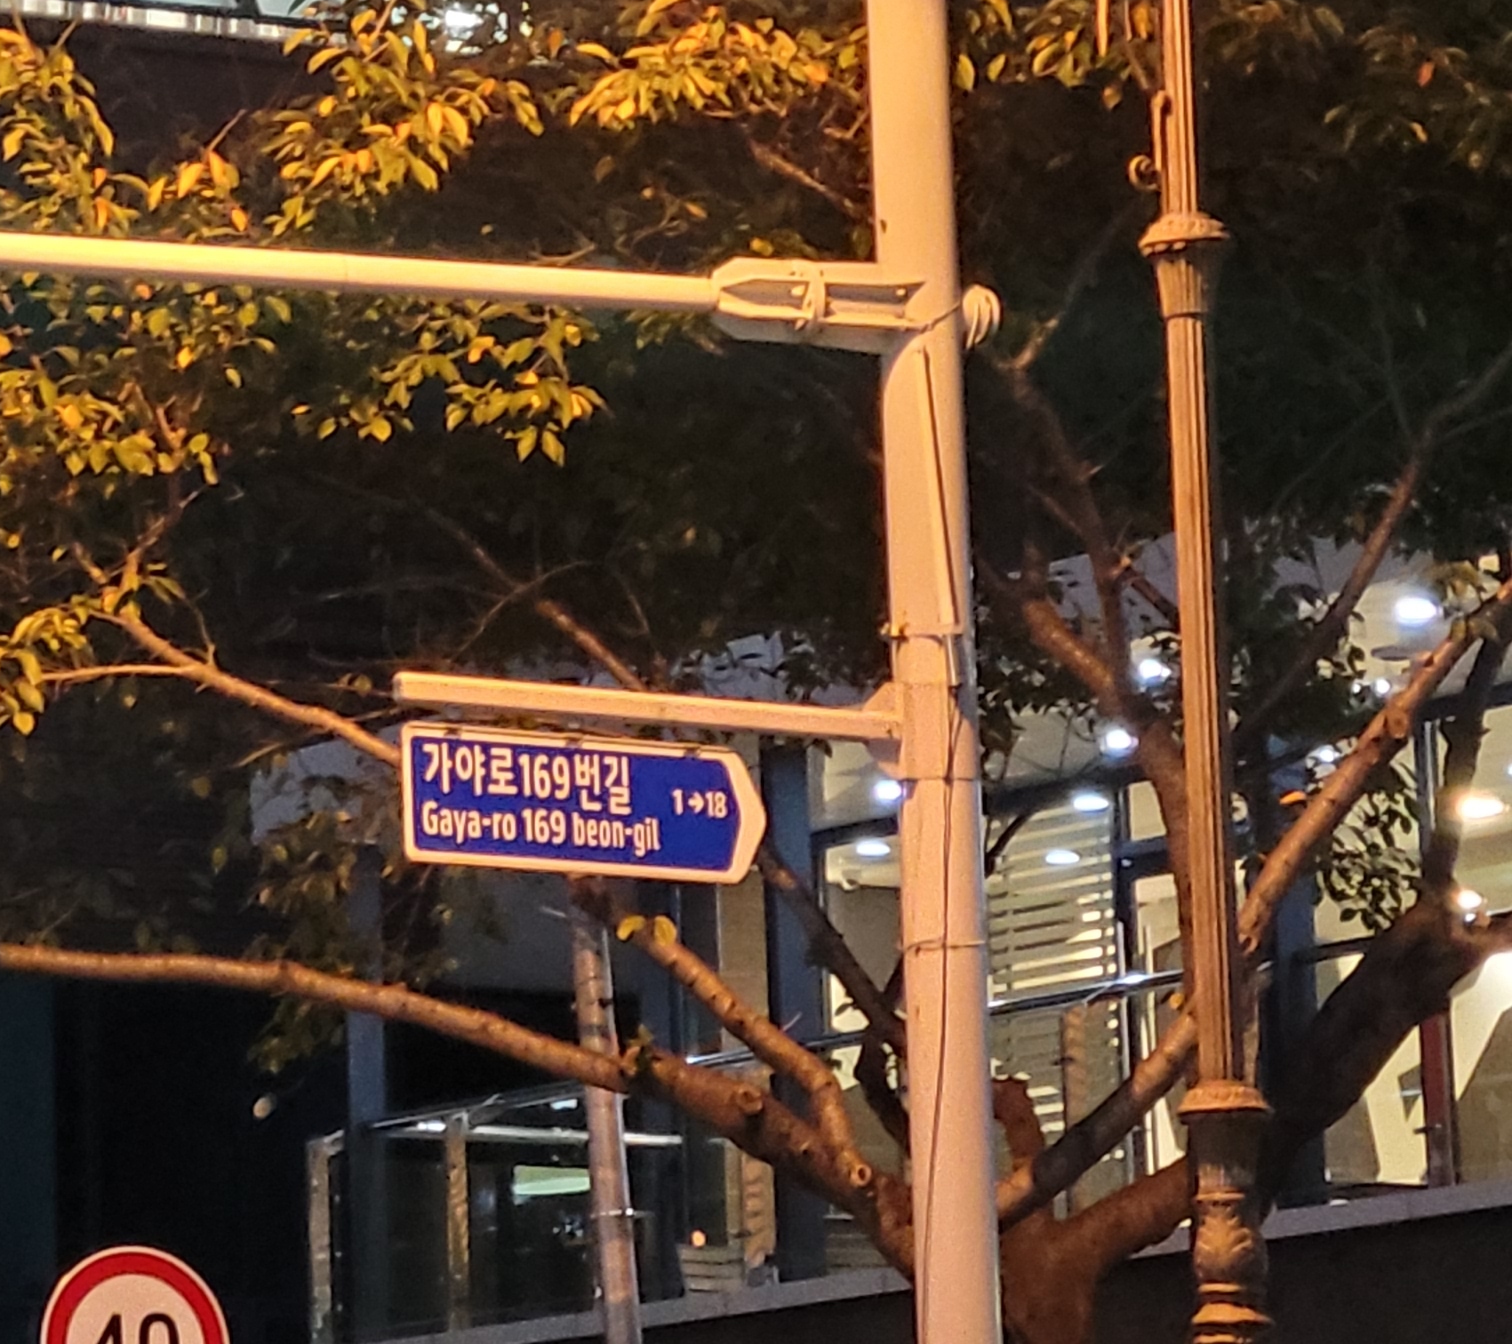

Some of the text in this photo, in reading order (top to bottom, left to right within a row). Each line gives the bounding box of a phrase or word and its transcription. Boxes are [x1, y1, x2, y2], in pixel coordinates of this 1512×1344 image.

[421, 743, 632, 815] 가야로169번길
[422, 801, 661, 857] Gaya-ro 169 beon-gil
